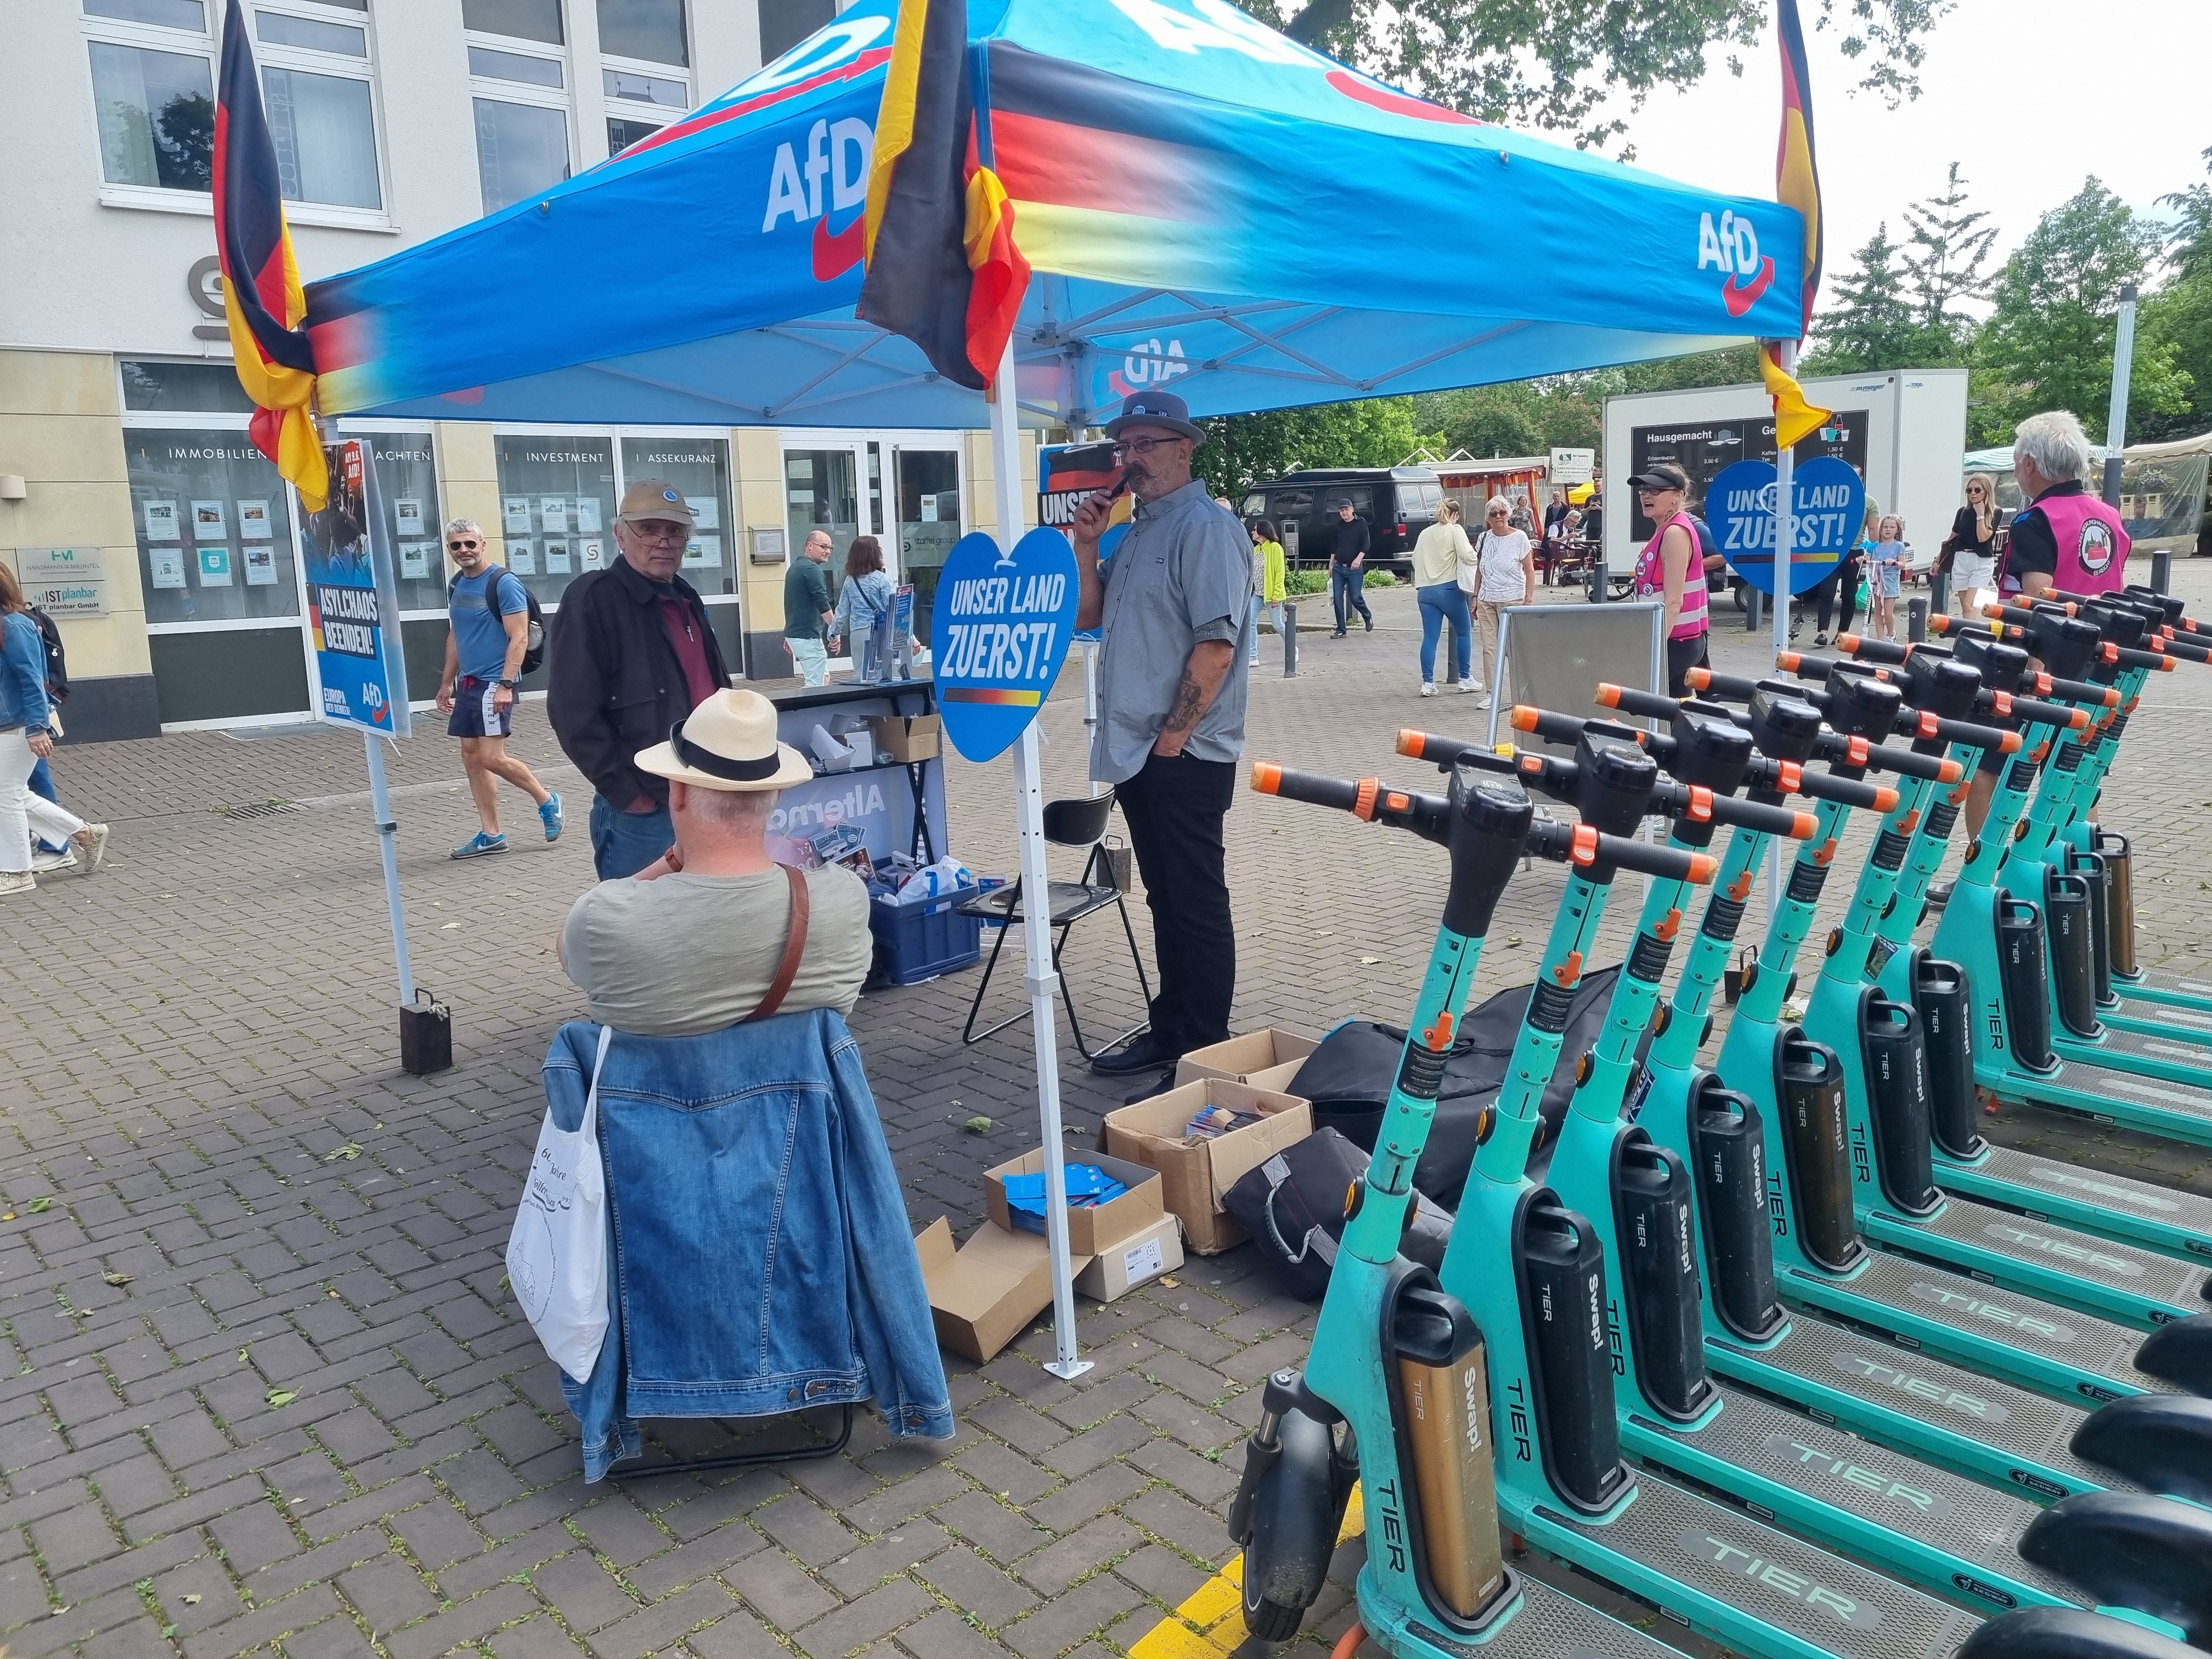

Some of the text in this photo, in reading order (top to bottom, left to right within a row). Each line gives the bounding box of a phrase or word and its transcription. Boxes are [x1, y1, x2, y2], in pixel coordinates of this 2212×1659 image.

[762, 117, 875, 233] AfD
[1697, 210, 1758, 274] AfD
[1647, 430, 1712, 443] Hausgemacht
[1762, 426, 1776, 435] Ge
[375, 450, 430, 461] ACHTEN
[526, 453, 603, 462] INVESTMENT
[648, 454, 716, 464] ASSEKURANZ
[1727, 484, 1850, 512] UNSE LAND
[1724, 513, 1846, 549] ZUERST!
[320, 588, 377, 622] ASYLCHAOS
[951, 577, 1008, 616] UNSER
[1010, 573, 1065, 614] LAND
[324, 621, 374, 655] BEENDEN!
[940, 623, 1057, 680] ZUERST!
[323, 687, 347, 706] EUROPA
[362, 681, 382, 707] AfD
[1931, 1007, 1939, 1034] TIER
[1962, 1002, 1971, 1056] Swap!
[1986, 997, 2004, 1051] TIER
[1881, 1052, 1889, 1081] TIER
[1915, 1047, 1925, 1103] Swap!
[1798, 1098, 1807, 1128] TIER
[1833, 1091, 1844, 1152] Swap!
[1713, 1152, 1723, 1184] TIER
[1753, 1143, 1764, 1209] Swap!
[1851, 1121, 1870, 1183] TIER
[1767, 1171, 1788, 1237] TIER
[1637, 1213, 1646, 1248] TIER
[1679, 1204, 1692, 1274] Swap!
[2005, 1229, 2127, 1271] TIER
[1542, 1284, 1553, 1322] TIER
[1589, 1273, 1605, 1351] Swap!
[1931, 1287, 2059, 1341] TIER
[1607, 1298, 1626, 1378] TIER
[1414, 1379, 1425, 1421] TIER
[1464, 1367, 1480, 1454] Swap!
[1853, 1357, 1990, 1418] TIER
[1506, 1377, 1532, 1463] TIER
[1790, 1441, 1938, 1512] TIER
[1378, 1477, 1405, 1574] TIER
[1705, 1536, 1858, 1623] TIER
